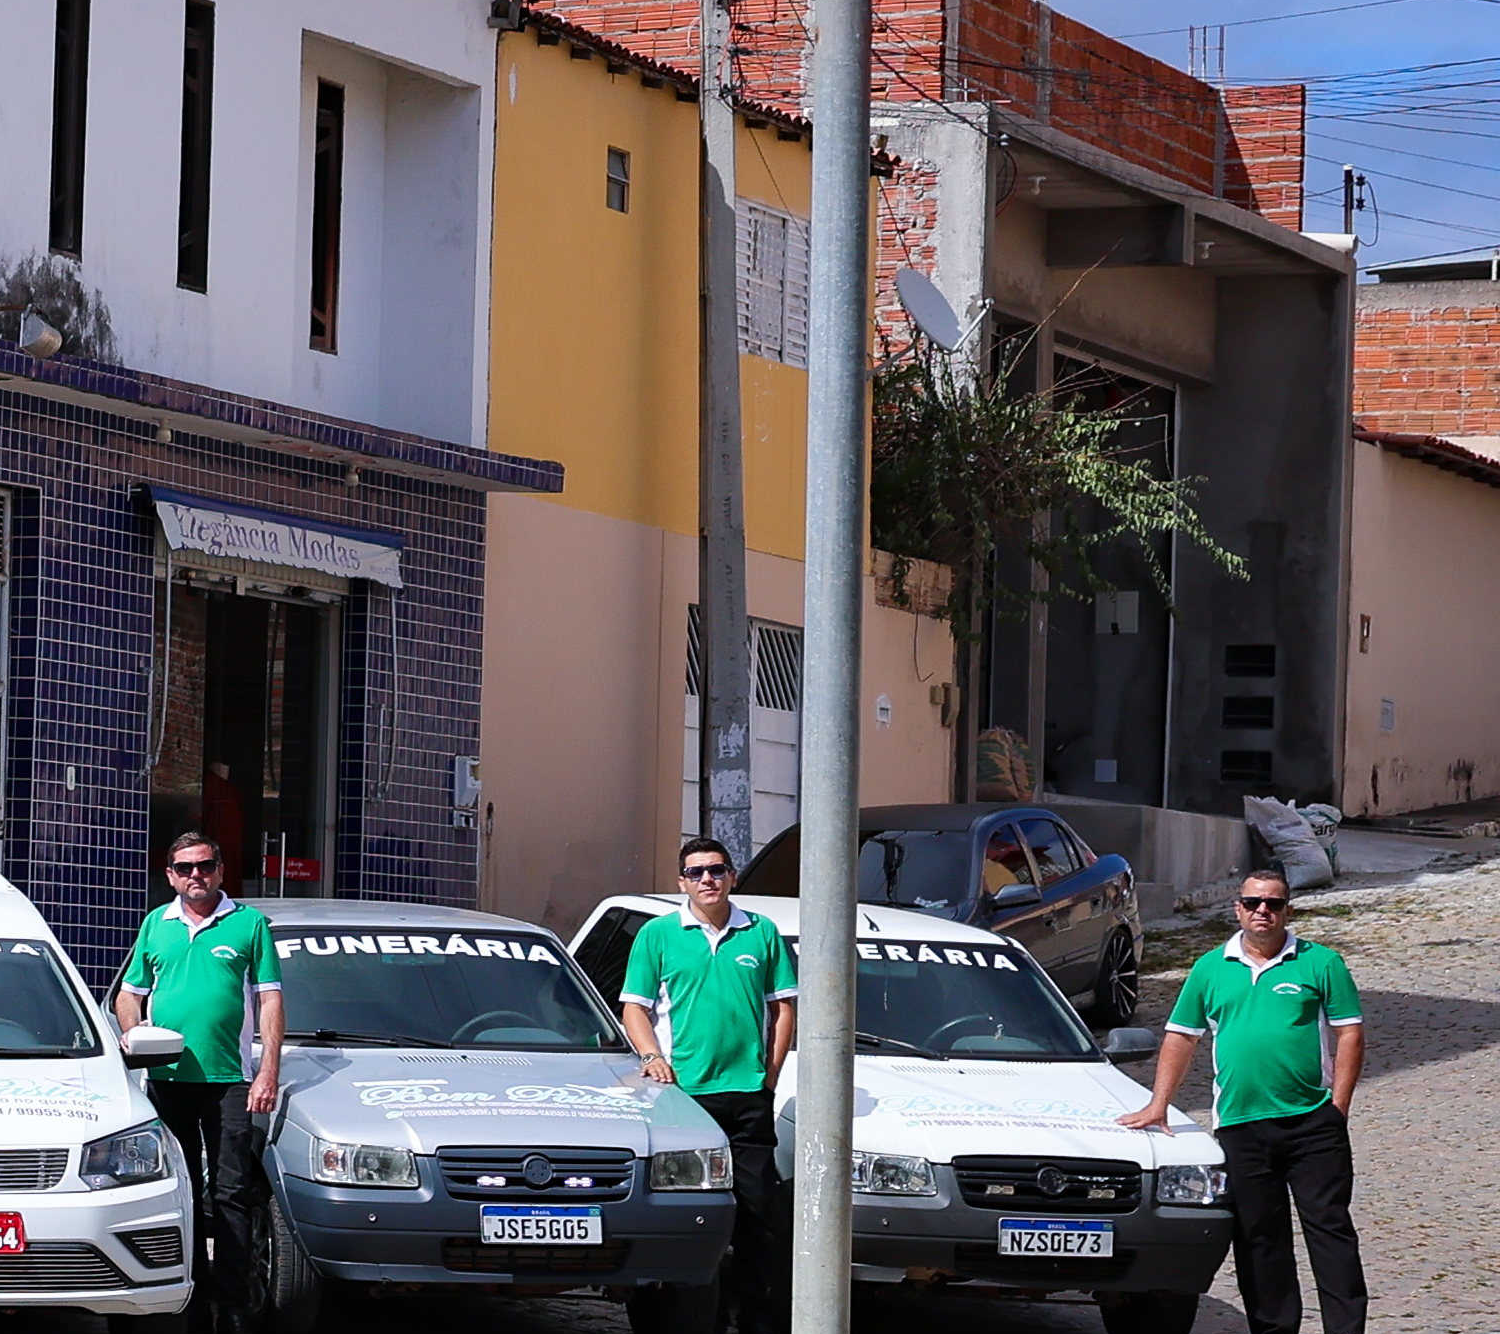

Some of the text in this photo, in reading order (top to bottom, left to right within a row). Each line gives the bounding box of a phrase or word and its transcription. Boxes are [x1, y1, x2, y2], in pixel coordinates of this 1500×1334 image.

[288, 524, 361, 570] Modas
[274, 933, 561, 966] FUNERÁRIA
[359, 1084, 496, 1106] Bom
[493, 1218, 588, 1240] JSE5G05
[1010, 1231, 1102, 1254] NZS0E73
